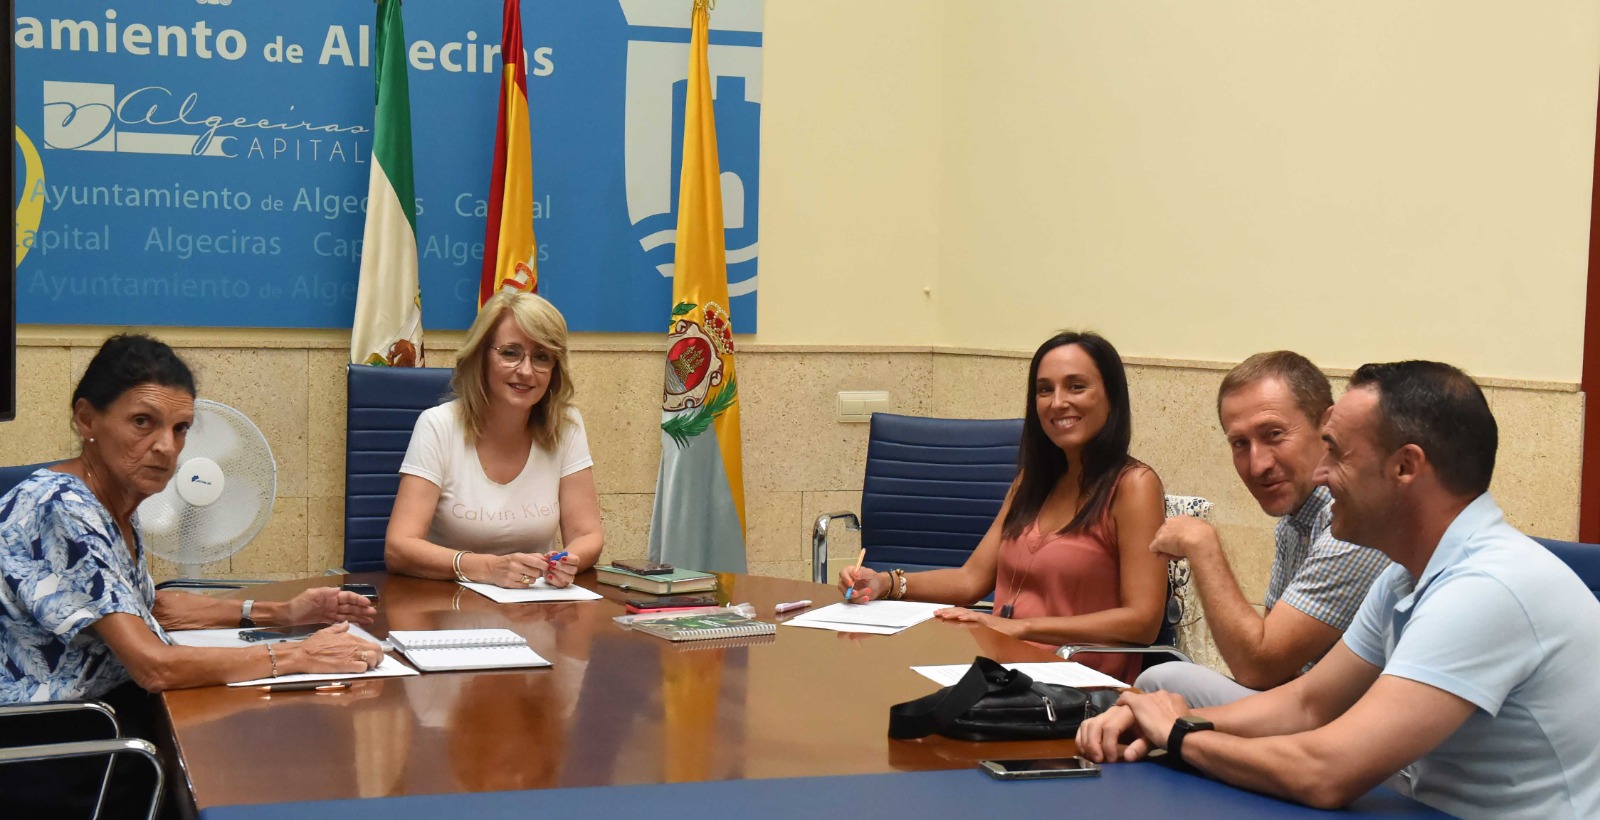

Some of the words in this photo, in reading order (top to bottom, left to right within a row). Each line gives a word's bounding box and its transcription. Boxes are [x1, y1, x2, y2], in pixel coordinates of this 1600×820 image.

[15, 9, 247, 60] amiento
[263, 36, 304, 64] de
[318, 24, 555, 77] Alecirs
[220, 136, 365, 164] CAPITAL
[30, 178, 251, 211] Ayuntamiento
[261, 195, 284, 211] de
[292, 187, 424, 219] Algecs
[455, 193, 551, 219] Caal
[15, 223, 110, 256] apital
[144, 226, 281, 259] Algeciras
[423, 234, 549, 265] Alges
[28, 269, 250, 302] Ayuntamiento
[452, 503, 516, 521] Calvin
